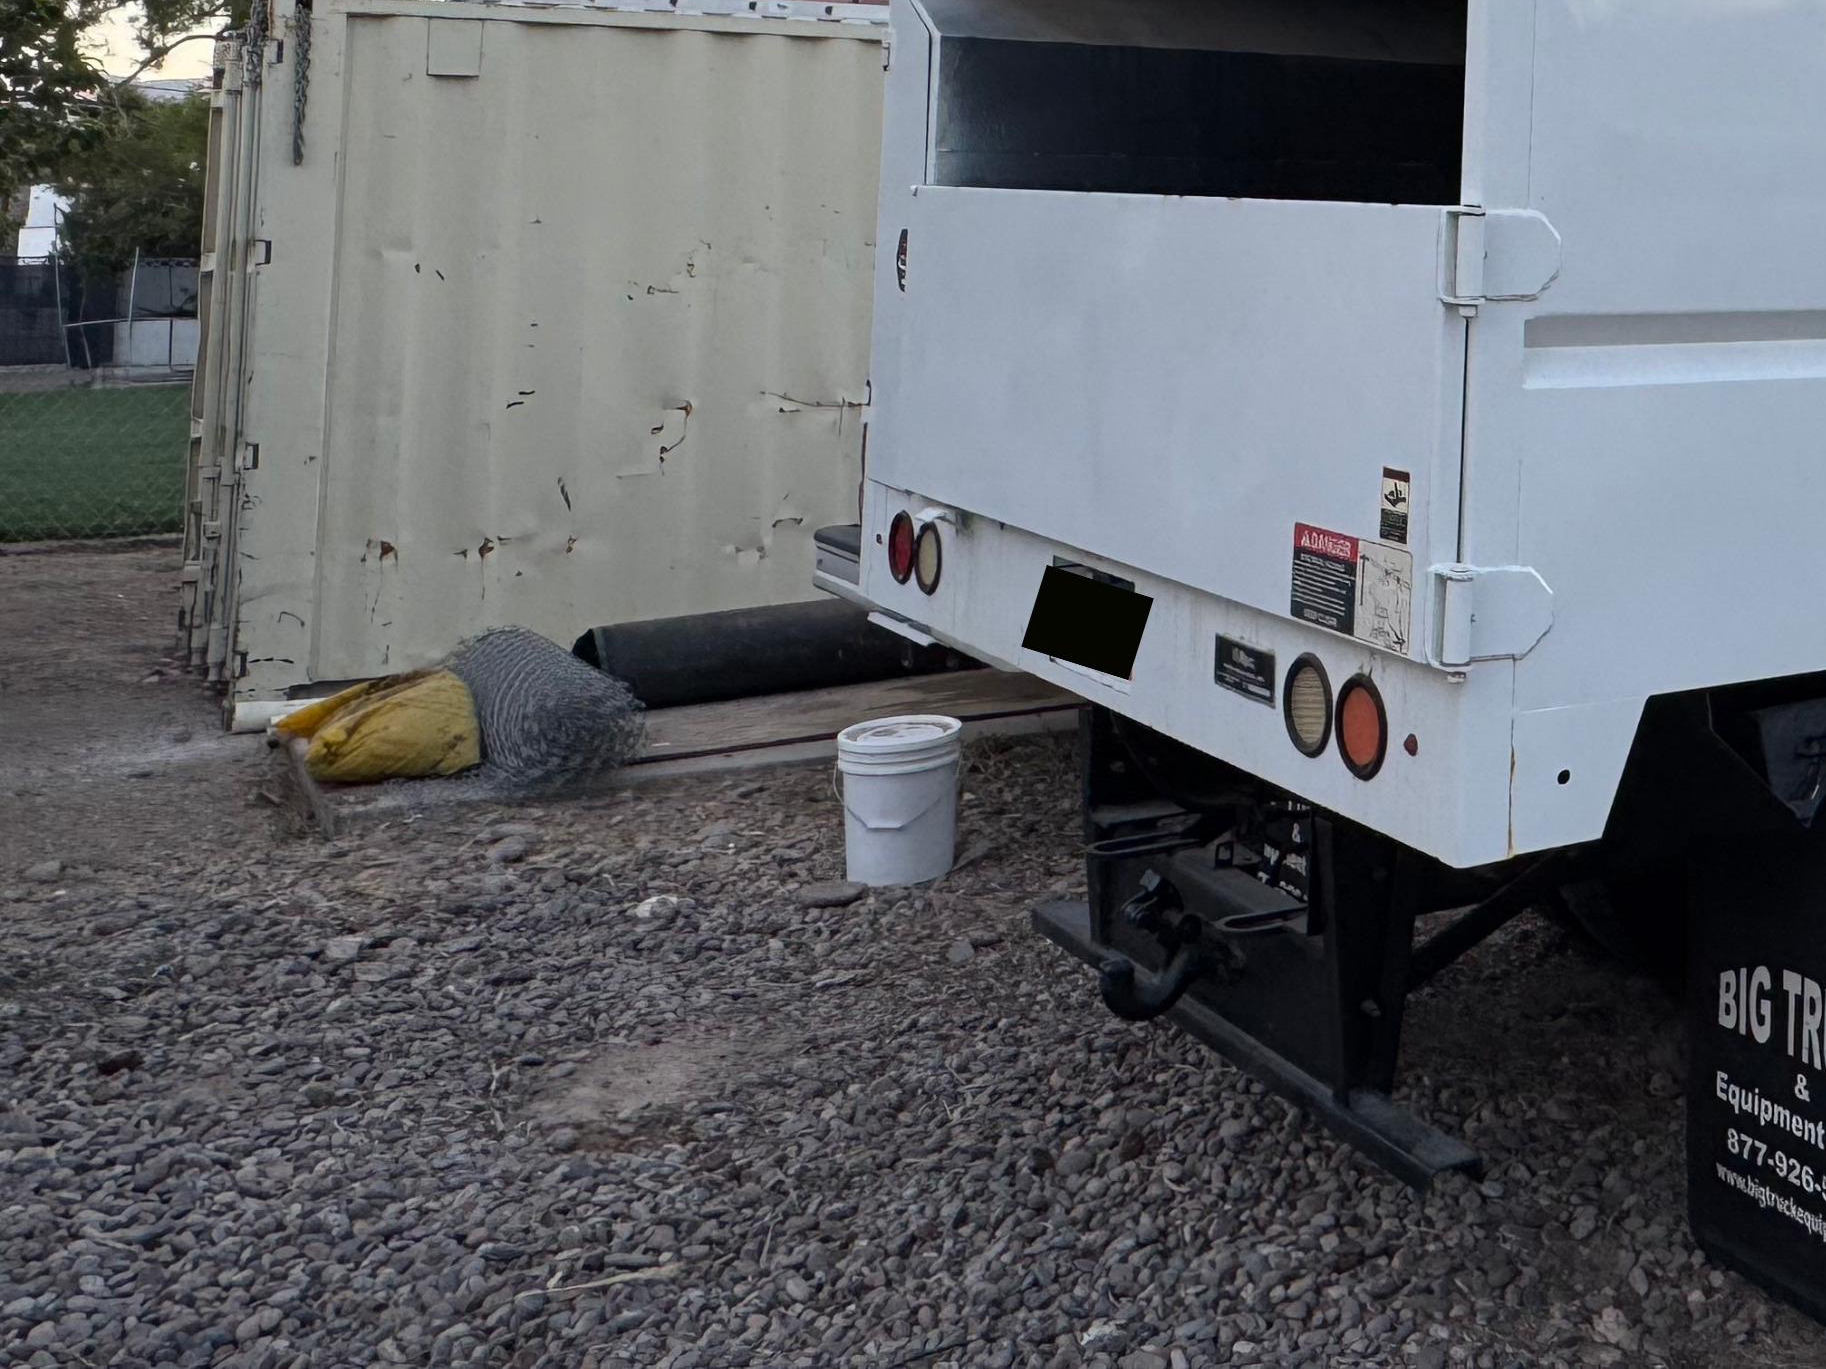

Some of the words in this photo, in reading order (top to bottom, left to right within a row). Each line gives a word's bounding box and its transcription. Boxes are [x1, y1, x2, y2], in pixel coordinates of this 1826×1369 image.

[1718, 965, 1772, 1044] BIG
[1716, 1070, 1826, 1150] Equipment
[1794, 1073, 1811, 1103] &
